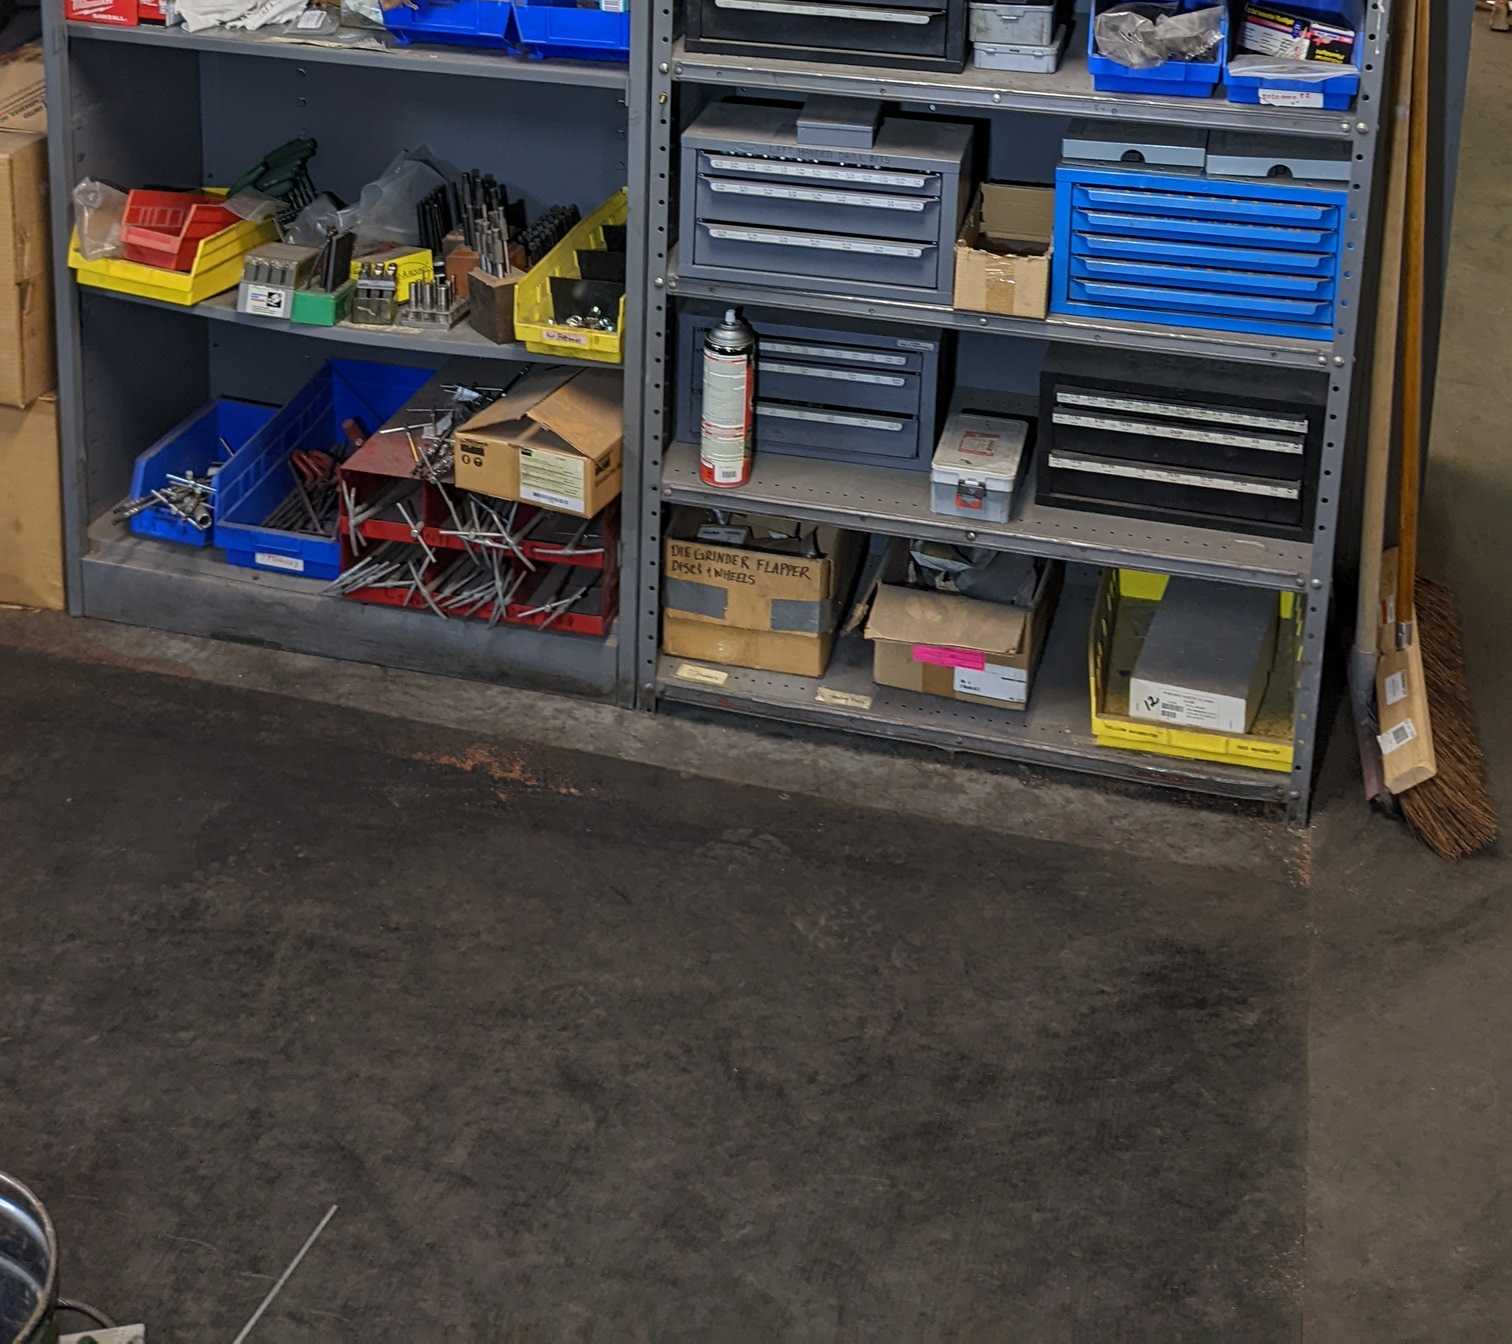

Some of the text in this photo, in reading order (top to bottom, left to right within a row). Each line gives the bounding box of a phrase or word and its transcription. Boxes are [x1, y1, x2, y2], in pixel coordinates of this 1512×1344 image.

[671, 545, 811, 580] DIE GRINDER FLAPPER
